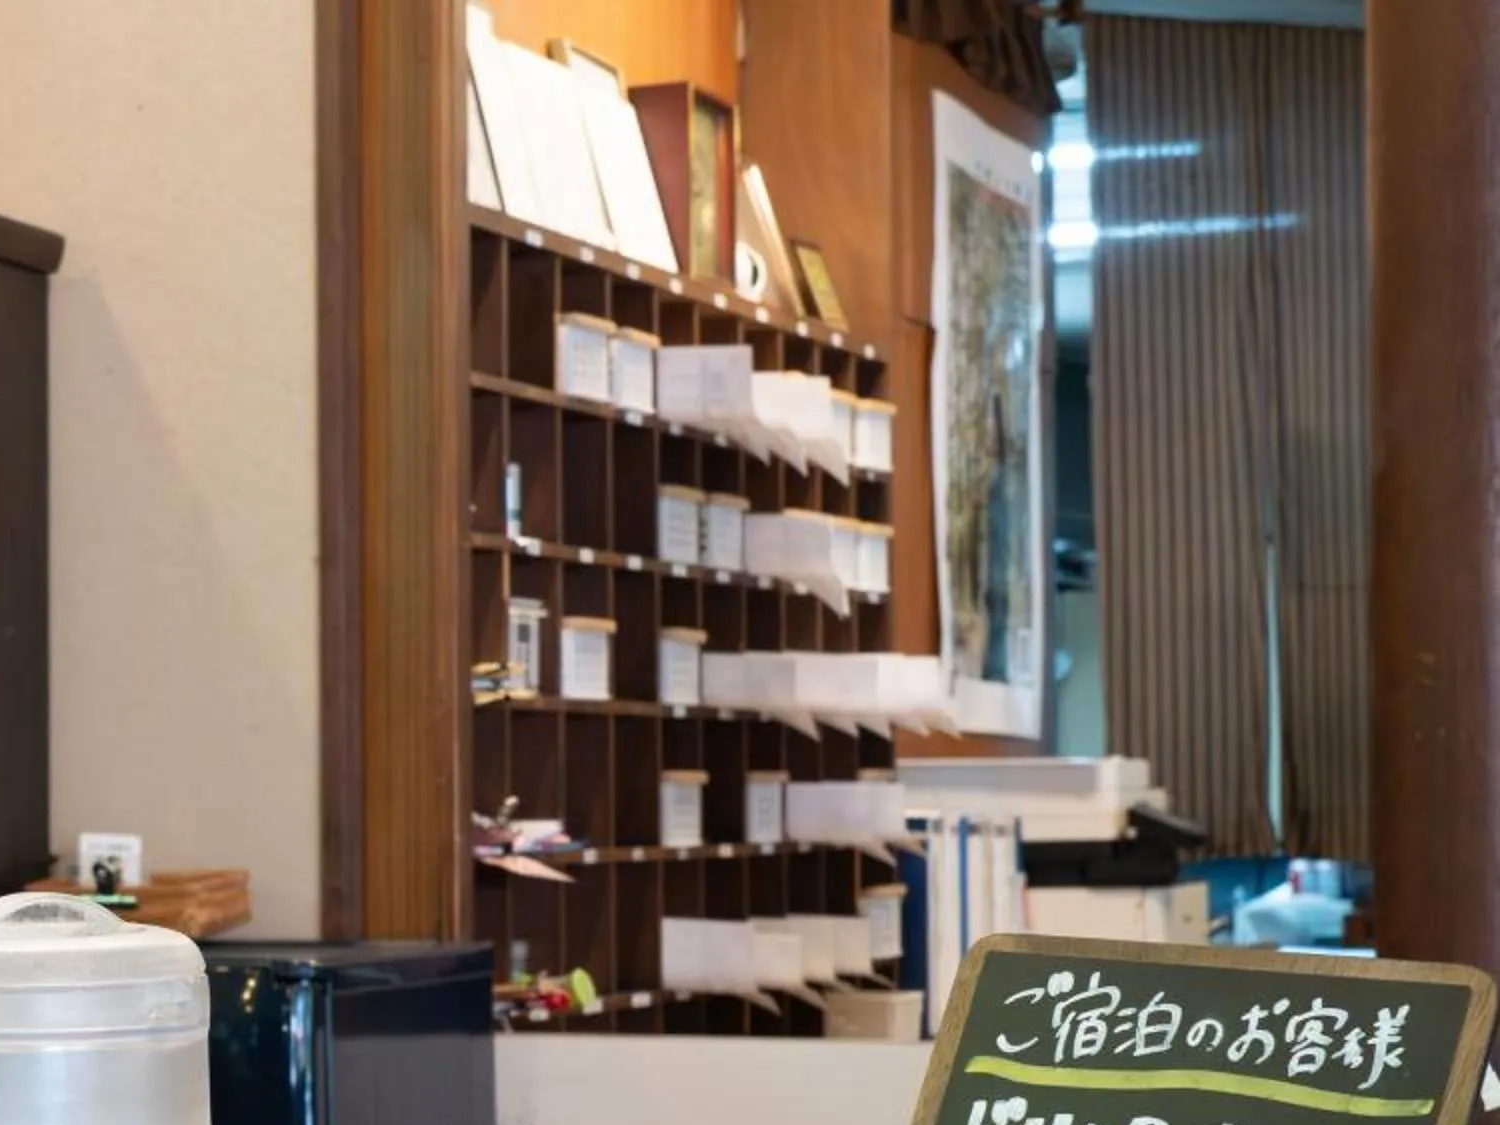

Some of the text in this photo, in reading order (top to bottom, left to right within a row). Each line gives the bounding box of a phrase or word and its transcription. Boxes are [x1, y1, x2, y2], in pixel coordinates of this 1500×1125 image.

[996, 971, 1410, 1090] ご宿泊のお客様
